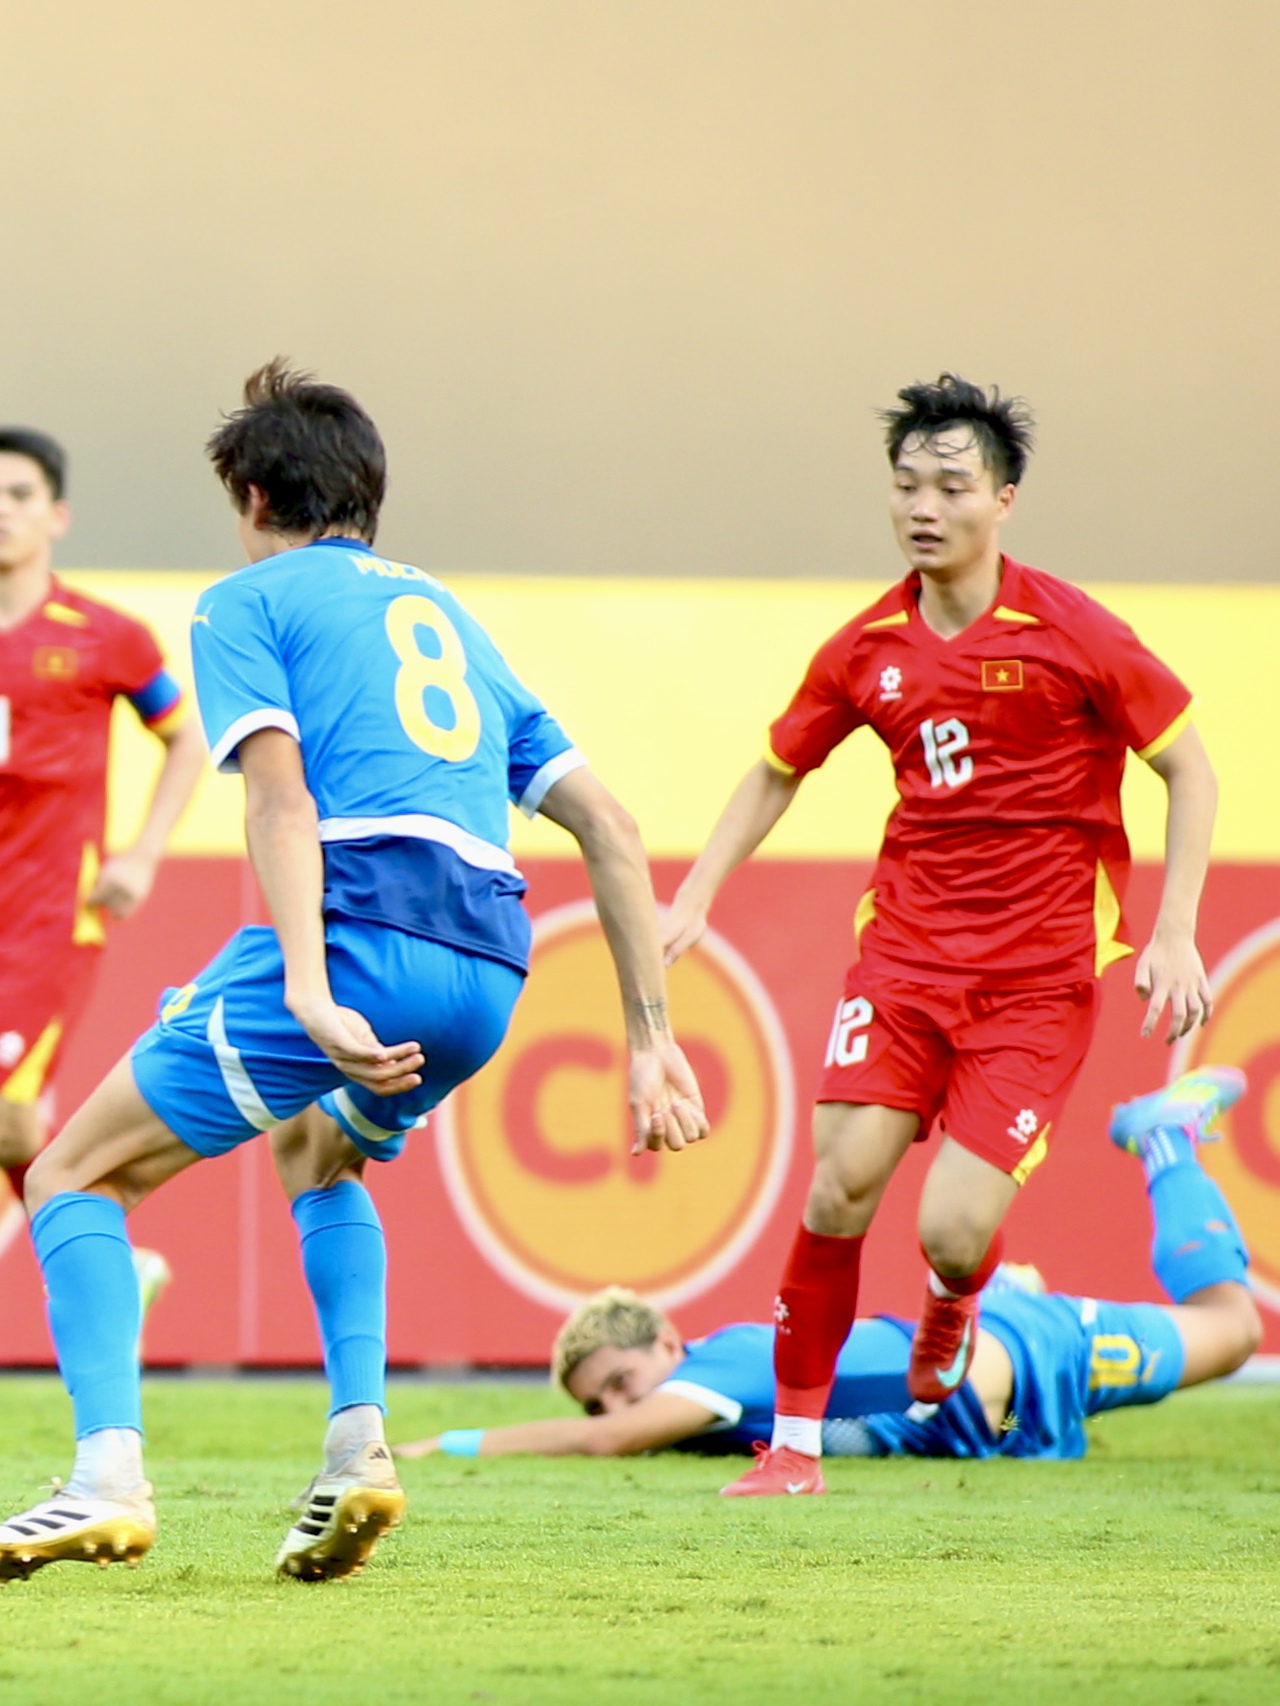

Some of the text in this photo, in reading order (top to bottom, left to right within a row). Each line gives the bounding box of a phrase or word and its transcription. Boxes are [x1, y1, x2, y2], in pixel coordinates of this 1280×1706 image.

[384, 594, 482, 763] 8
[919, 717, 974, 789] 12
[823, 995, 874, 1068] 12
[1088, 1334, 1141, 1392] 10
